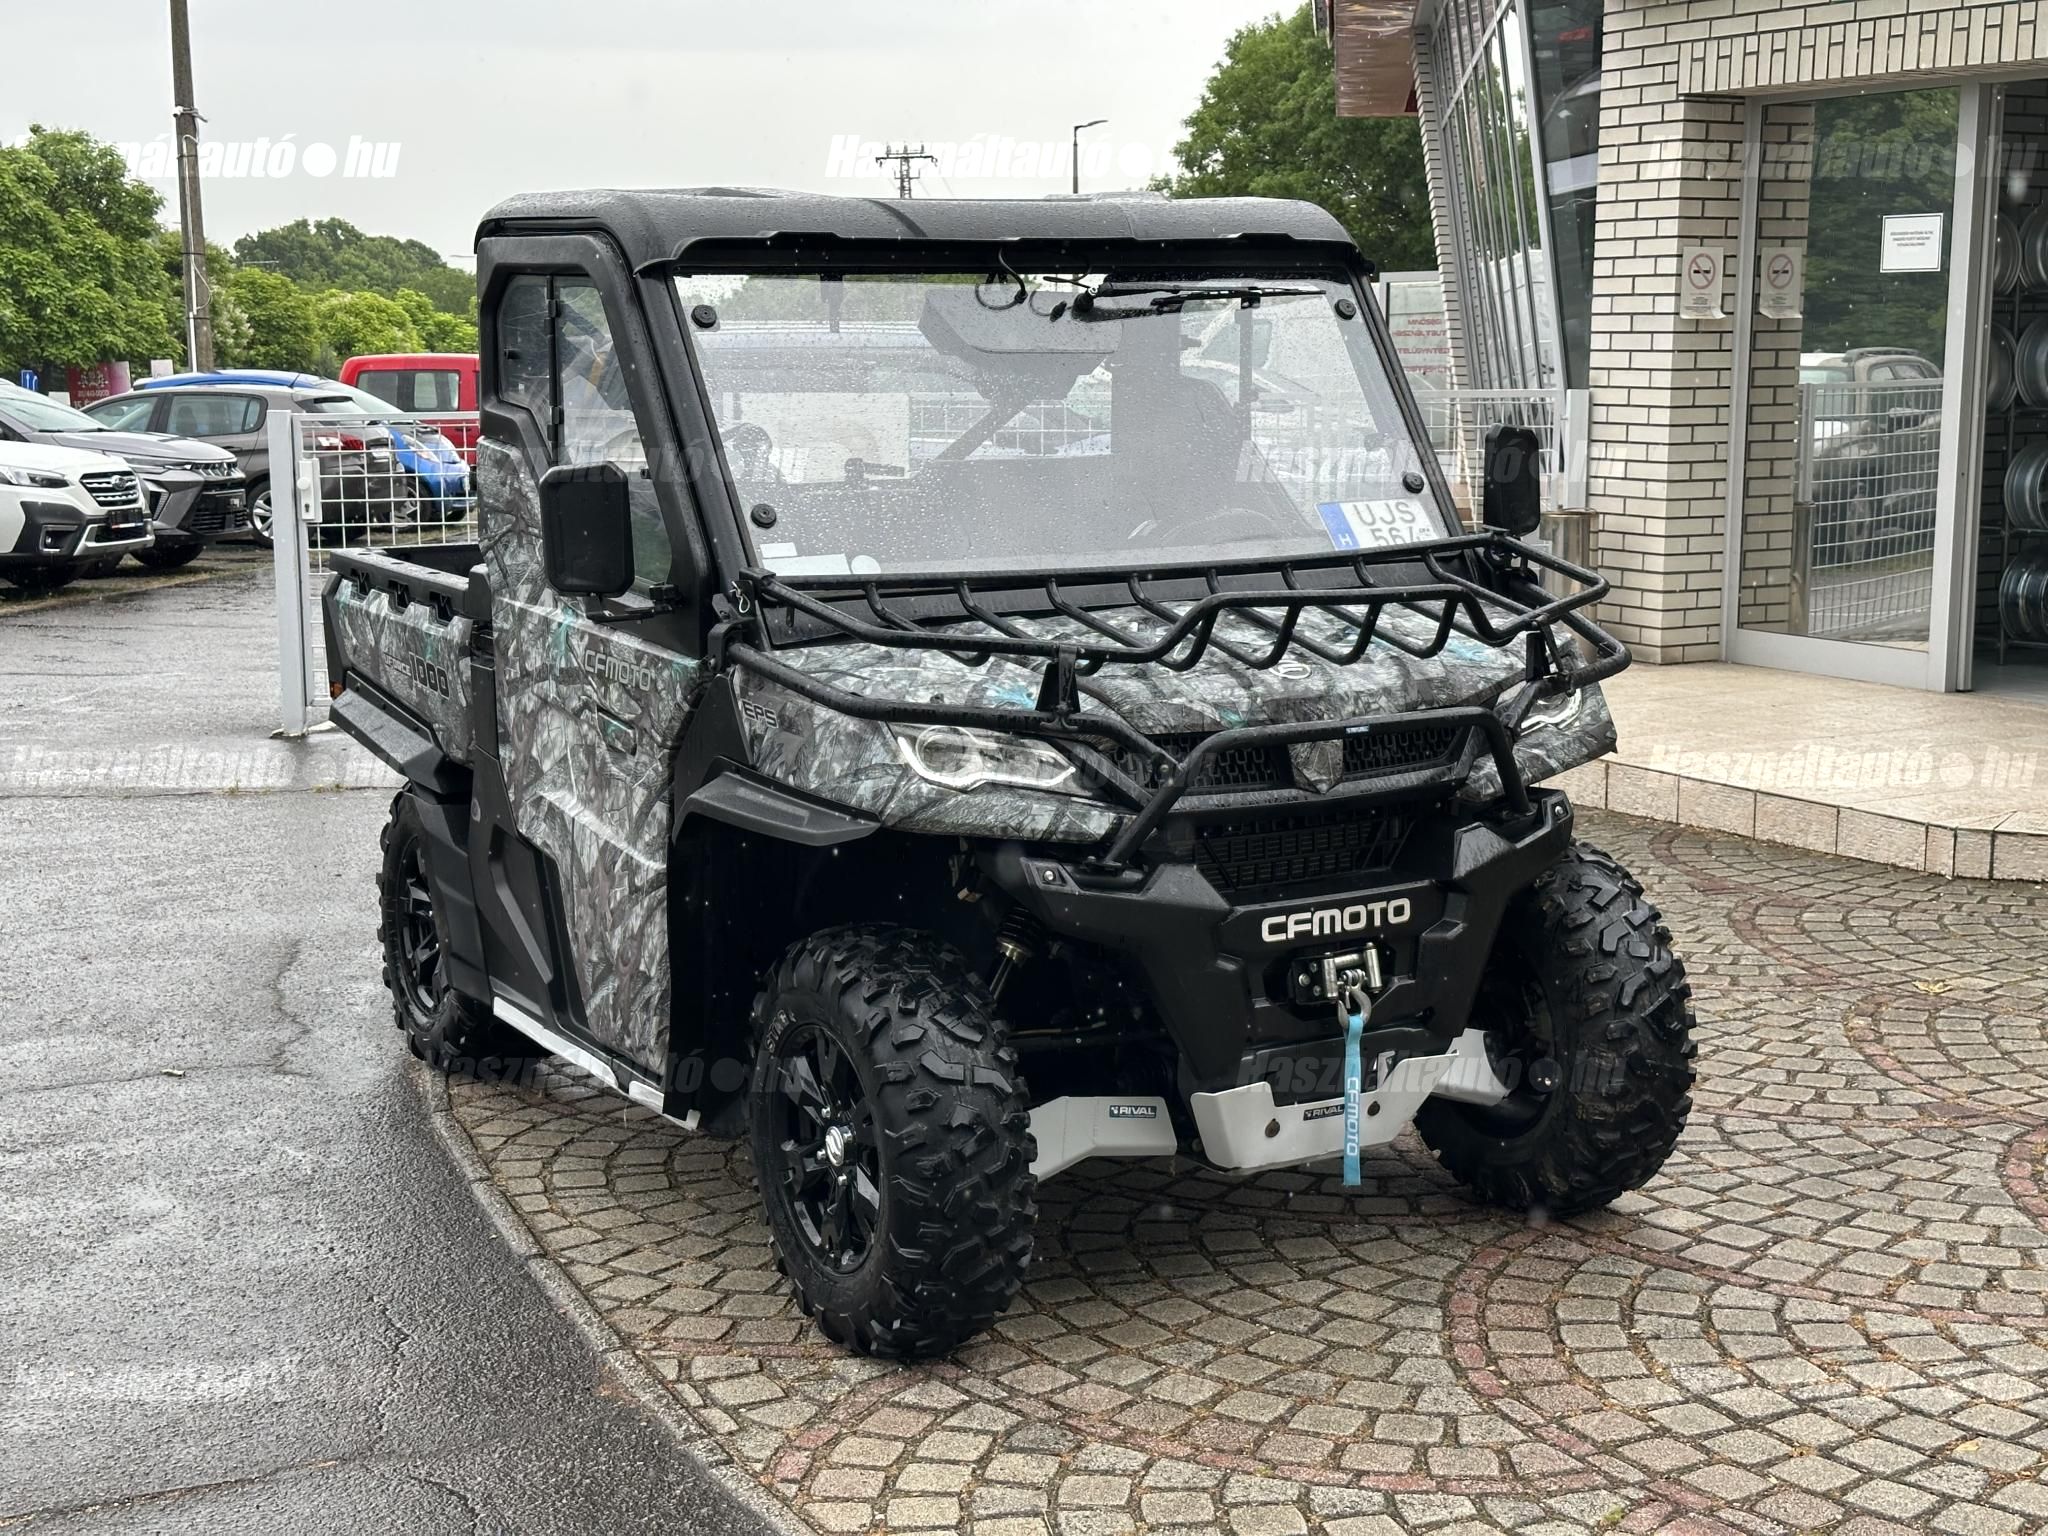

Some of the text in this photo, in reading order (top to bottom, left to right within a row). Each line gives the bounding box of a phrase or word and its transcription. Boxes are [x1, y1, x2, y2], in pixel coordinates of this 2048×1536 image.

[1353, 500, 1416, 526] UJS
[1339, 533, 1353, 547] H
[409, 651, 450, 701] 1000
[584, 649, 651, 692] CFMOTO
[741, 699, 779, 729] EPS
[1261, 897, 1411, 943] CFMOTO
[1119, 1106, 1156, 1115] RIVAL
[1312, 1105, 1344, 1117] RIVAL
[1346, 1076, 1360, 1156] CFMOTO
